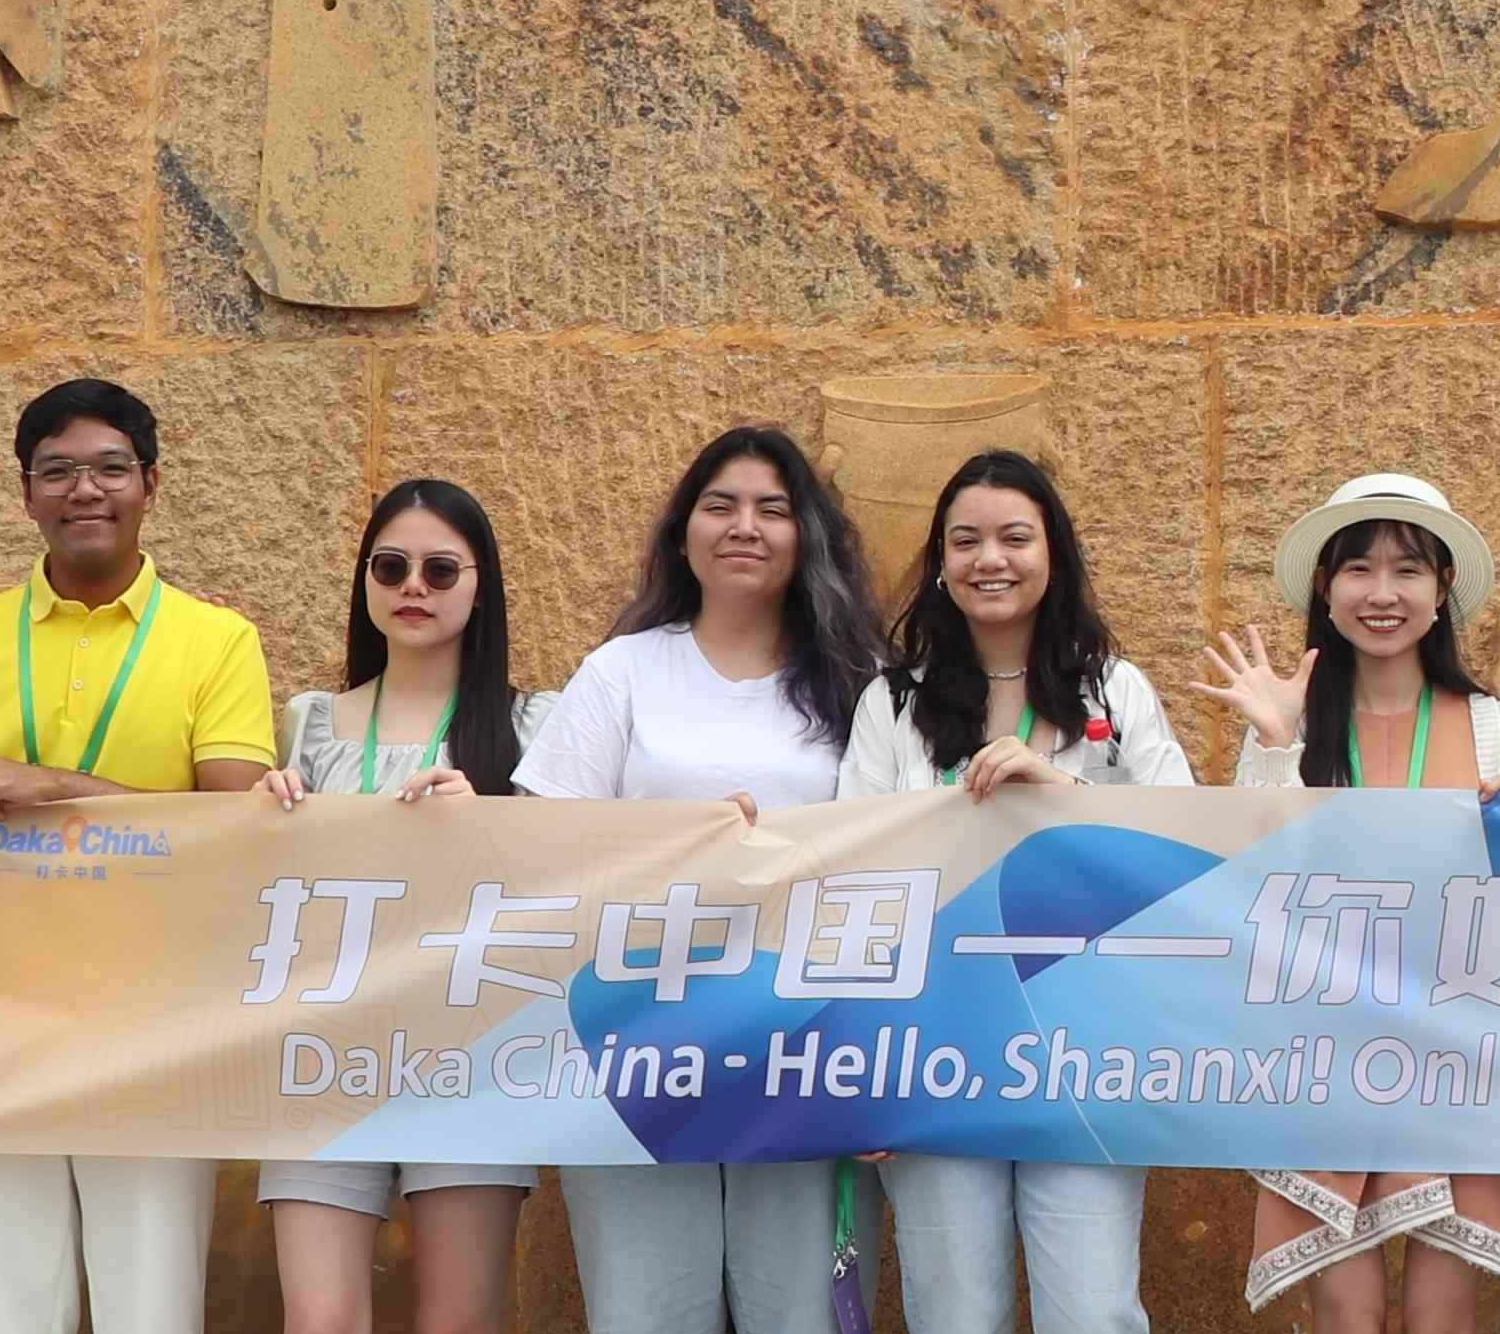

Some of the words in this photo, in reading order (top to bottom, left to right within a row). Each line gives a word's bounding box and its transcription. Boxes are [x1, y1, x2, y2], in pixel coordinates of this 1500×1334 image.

[278, 1028, 474, 1099] Daka
[491, 1029, 705, 1101] China
[764, 1025, 986, 1101] Hello,
[998, 1027, 1337, 1105] Shaanxi!
